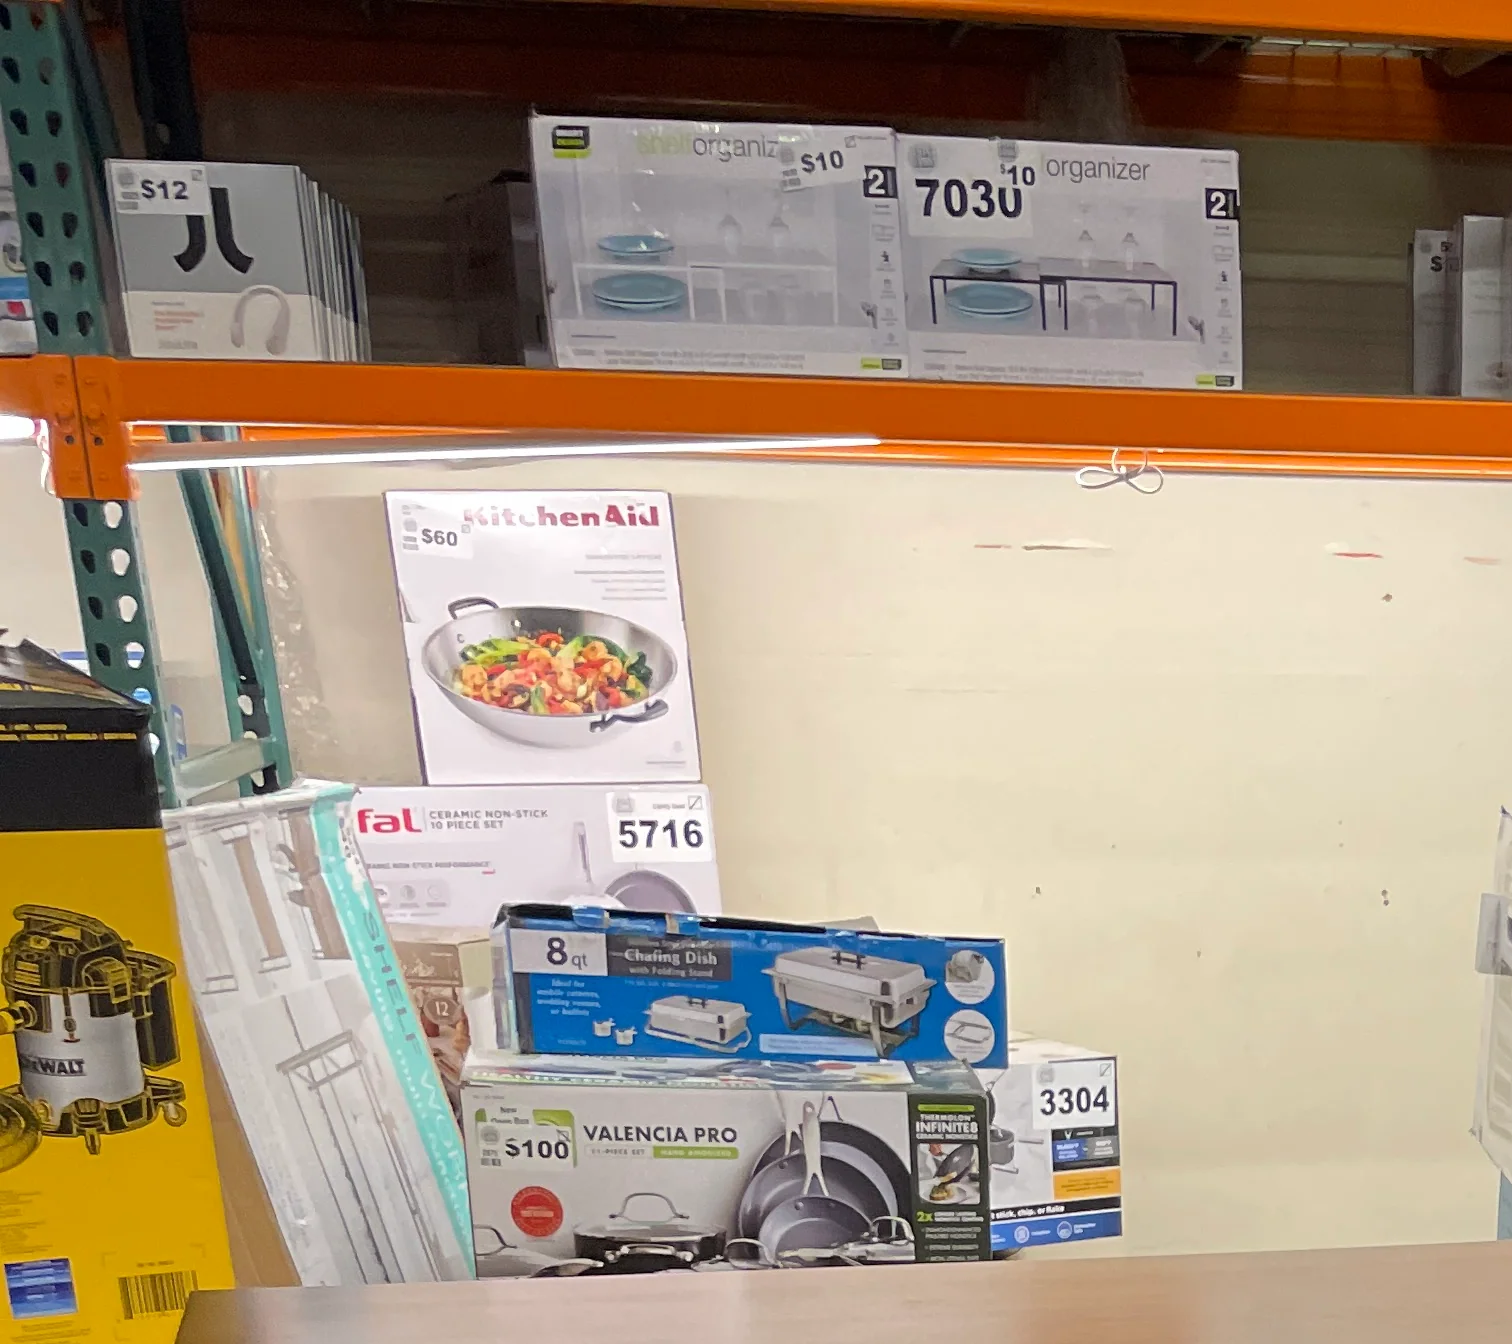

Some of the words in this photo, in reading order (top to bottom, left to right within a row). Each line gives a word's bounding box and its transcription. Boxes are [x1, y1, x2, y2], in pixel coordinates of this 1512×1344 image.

[692, 134, 779, 162] organiz
[800, 150, 844, 174] $10
[1046, 156, 1151, 182] organizer
[866, 169, 886, 194] 2
[1000, 164, 1036, 187] $10
[140, 179, 189, 201] $12
[914, 178, 1023, 218] 7030
[1210, 191, 1227, 217] 2
[463, 503, 660, 528] KitchenAid
[420, 528, 459, 547] $60
[356, 807, 422, 834] fal
[428, 810, 482, 820] CERAMIC
[485, 809, 549, 819] NON-STICK
[446, 820, 481, 830] PIECE
[483, 820, 504, 829] SET
[619, 818, 704, 849] 5716
[546, 936, 568, 966] 8
[571, 953, 589, 970] qt
[624, 948, 680, 967] Chafing
[685, 950, 718, 966] Dish
[434, 1001, 450, 1017] 12
[1039, 1085, 1110, 1116] 3304
[583, 1124, 688, 1143] VALENCIA
[694, 1126, 738, 1143] PRO
[504, 1138, 570, 1160] $100
